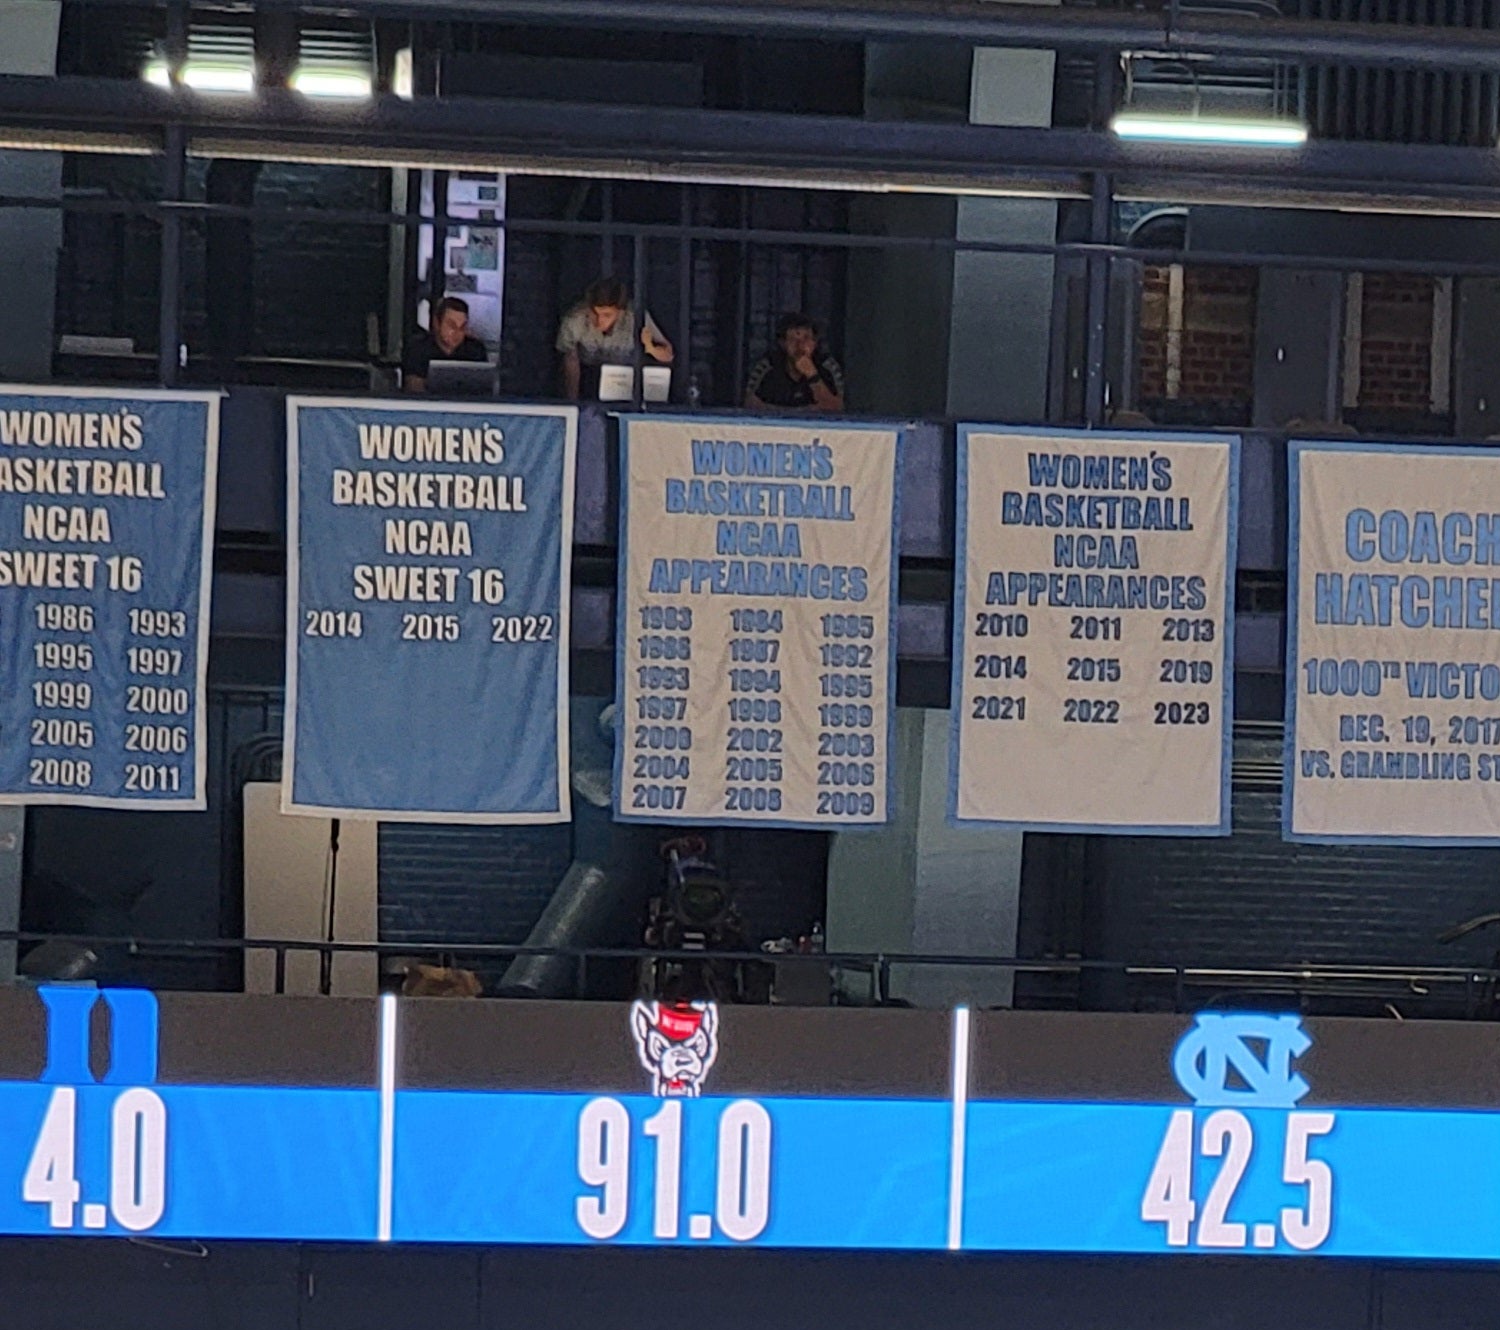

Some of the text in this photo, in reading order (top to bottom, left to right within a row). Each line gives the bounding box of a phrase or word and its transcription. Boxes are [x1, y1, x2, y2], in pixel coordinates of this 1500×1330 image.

[0, 408, 143, 450] WOMEN'S
[358, 421, 505, 465] WOMEN'S
[691, 438, 834, 479] WOMEN'S
[1027, 451, 1172, 491] WOMEN'S
[332, 469, 527, 512] BASKETBALL
[665, 479, 855, 521] BASKETBALL
[23, 504, 112, 543] NCAA
[1002, 491, 1194, 532] BASKETBALL
[384, 519, 472, 557] NCAA
[716, 521, 801, 558] NCAA
[1054, 534, 1140, 570] NCAA
[0, 551, 143, 592] SWEET 16
[353, 565, 505, 605] SWEET 16
[648, 558, 868, 601] APPEARANCES
[985, 571, 1207, 611] APPEARANCES
[35, 603, 187, 638] 1986 1993
[305, 610, 554, 643] 2014 2015 2022
[975, 612, 1215, 642] 2010 2011 2013
[34, 642, 182, 676] 1995 1997
[974, 655, 1213, 684] 2014 2015 2019
[32, 680, 188, 715] 1999 2000
[972, 696, 1210, 725] 2021 2022 2023
[31, 719, 188, 754] 2005 2006
[1339, 714, 1390, 743] DEC.
[30, 758, 180, 792] 2008 2011
[633, 754, 690, 780] 2004
[1300, 750, 1336, 779] VS.
[1340, 751, 1471, 781] GRAMBLING
[632, 784, 687, 810] 2007
[22, 1086, 167, 1232] 4.0
[575, 1096, 772, 1241] 91.0
[1141, 1109, 1337, 1251] 42.5
